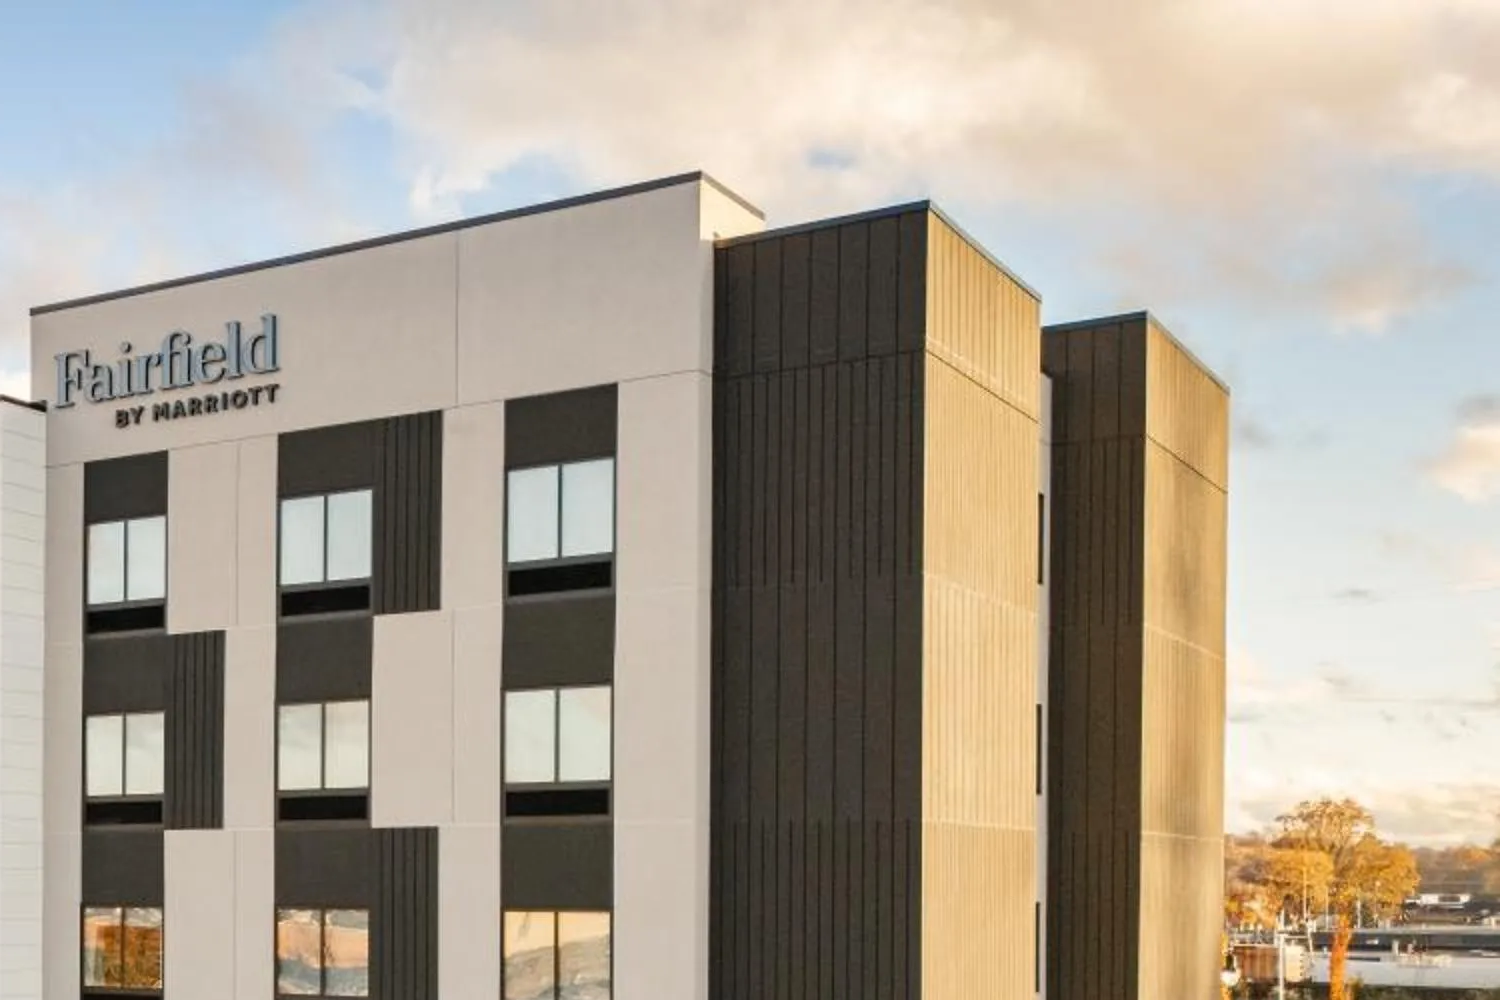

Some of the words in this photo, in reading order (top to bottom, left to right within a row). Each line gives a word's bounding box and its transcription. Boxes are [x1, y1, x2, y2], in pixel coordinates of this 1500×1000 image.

[54, 313, 281, 409] Fairfield
[115, 406, 145, 428] BY
[153, 384, 280, 422] MARRIOTT
